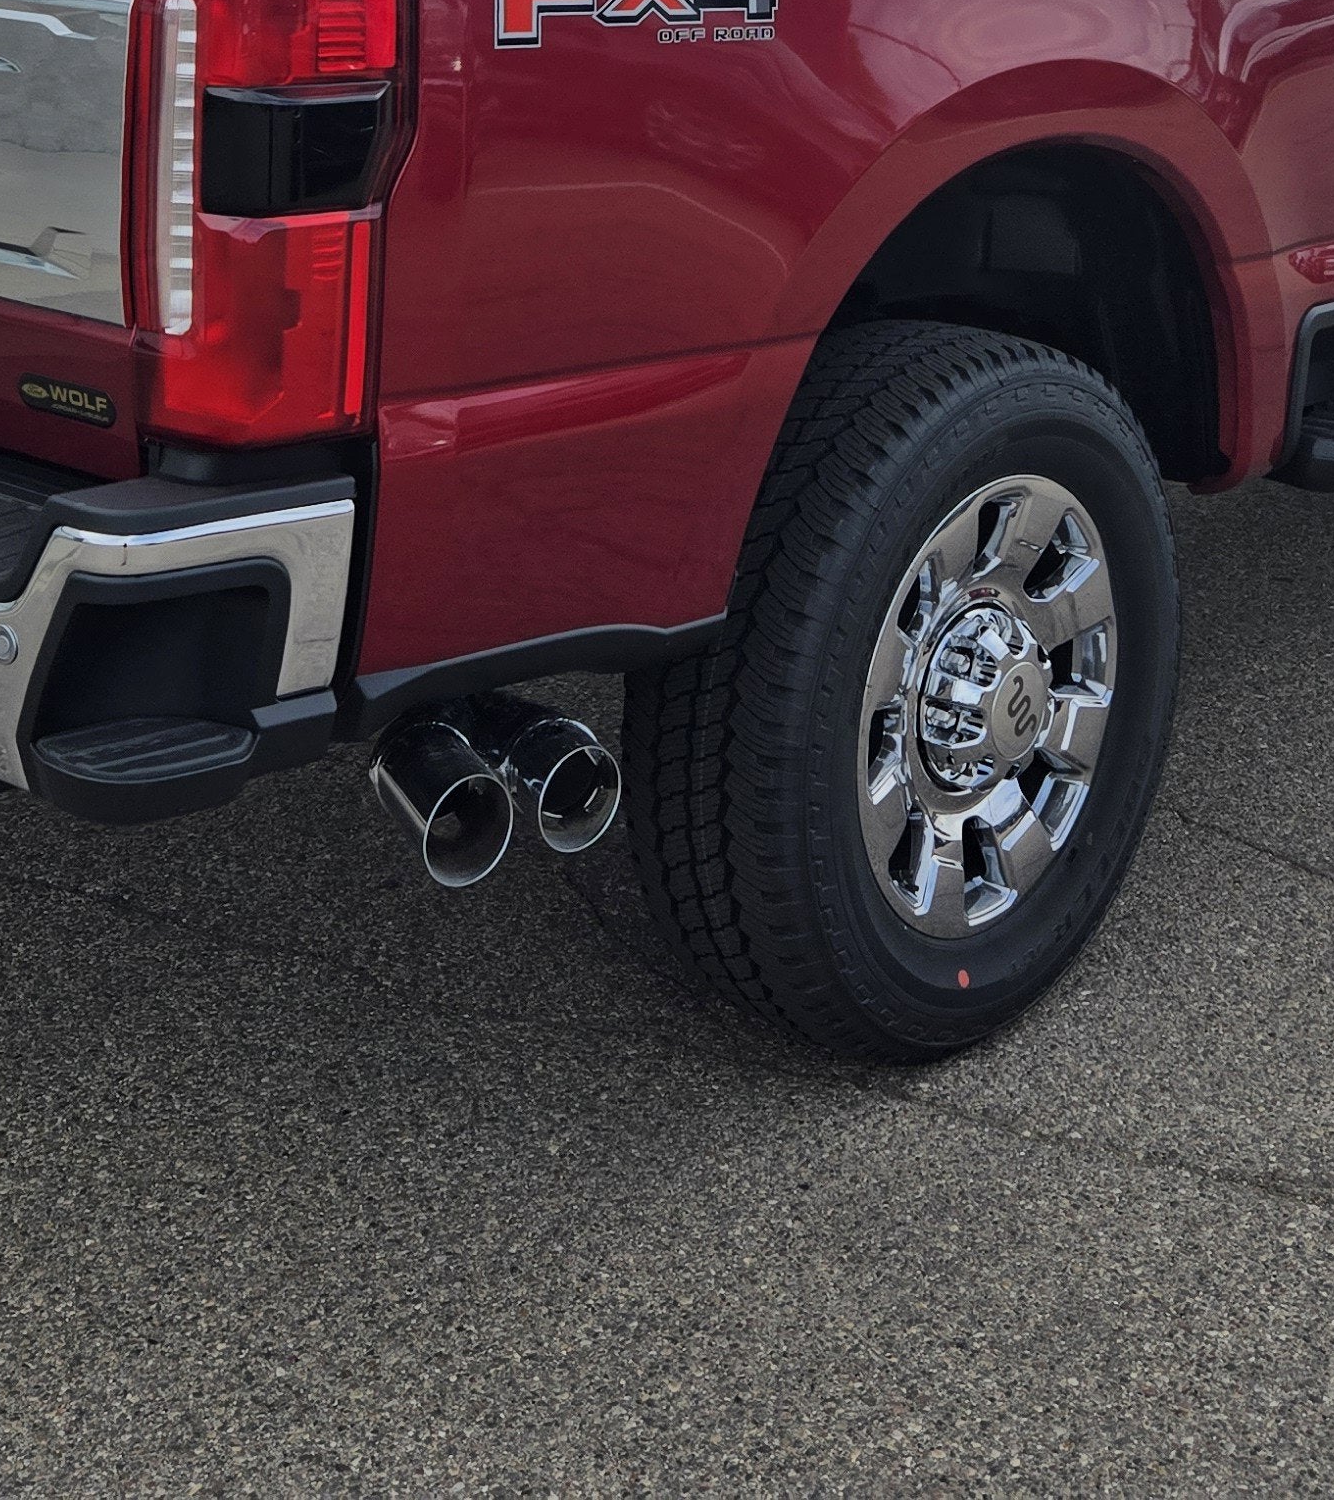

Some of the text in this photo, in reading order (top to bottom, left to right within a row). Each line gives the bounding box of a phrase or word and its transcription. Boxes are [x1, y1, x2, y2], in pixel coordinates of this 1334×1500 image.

[657, 25, 776, 44] OFF ROAD
[49, 384, 107, 413] WOLF
